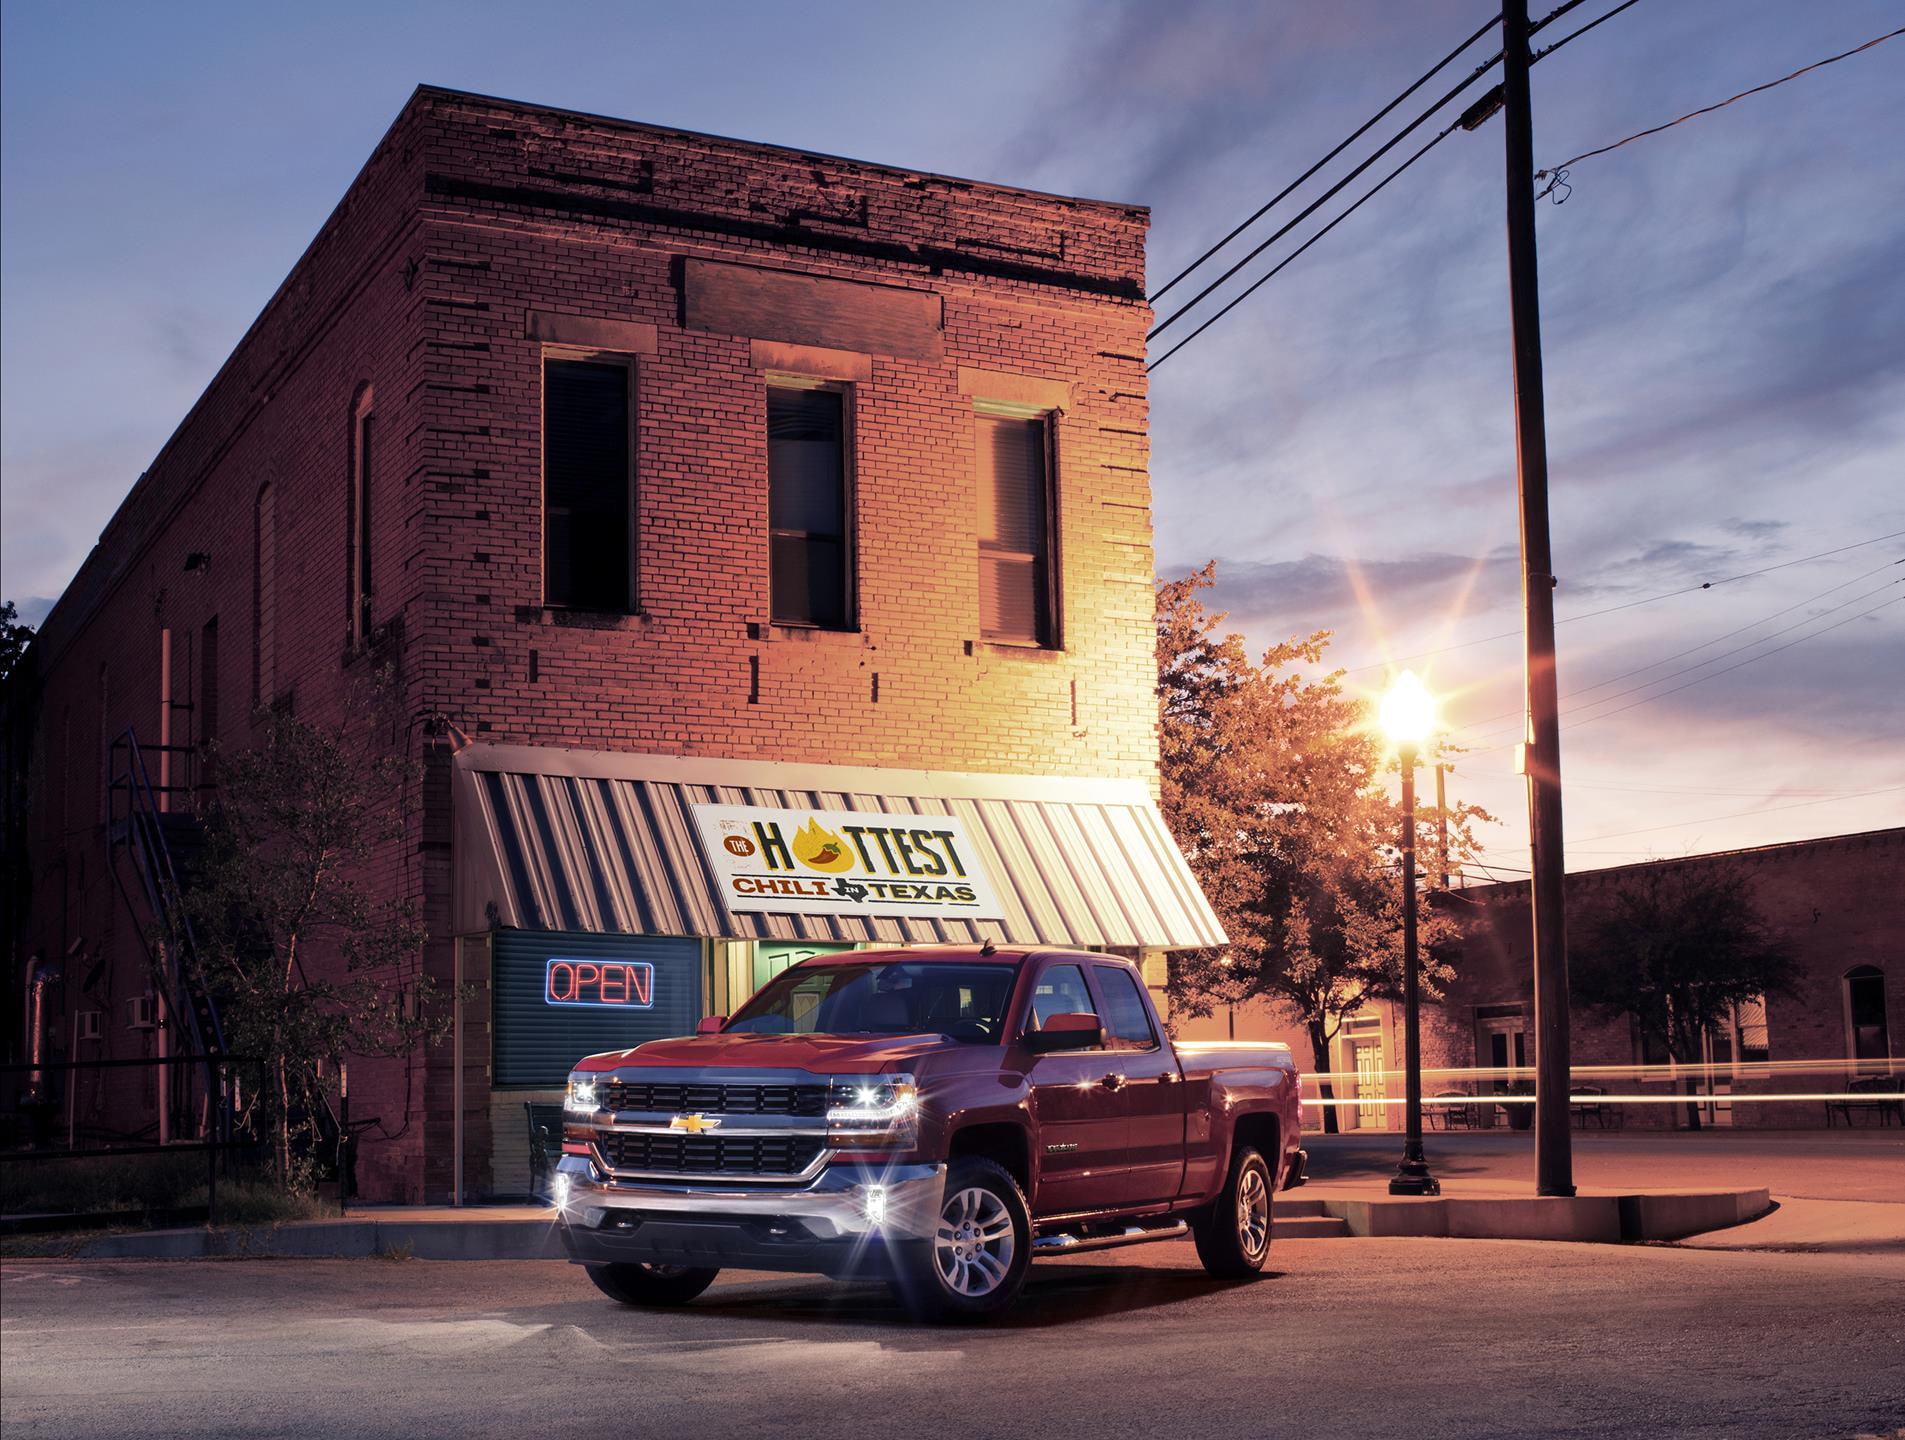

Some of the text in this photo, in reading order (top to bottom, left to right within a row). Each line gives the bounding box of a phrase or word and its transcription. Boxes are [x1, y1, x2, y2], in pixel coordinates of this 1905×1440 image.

[729, 840, 750, 853] THE
[732, 878, 830, 896] CHILI
[867, 883, 977, 901] TEXAS
[550, 963, 650, 1004] OPEN
